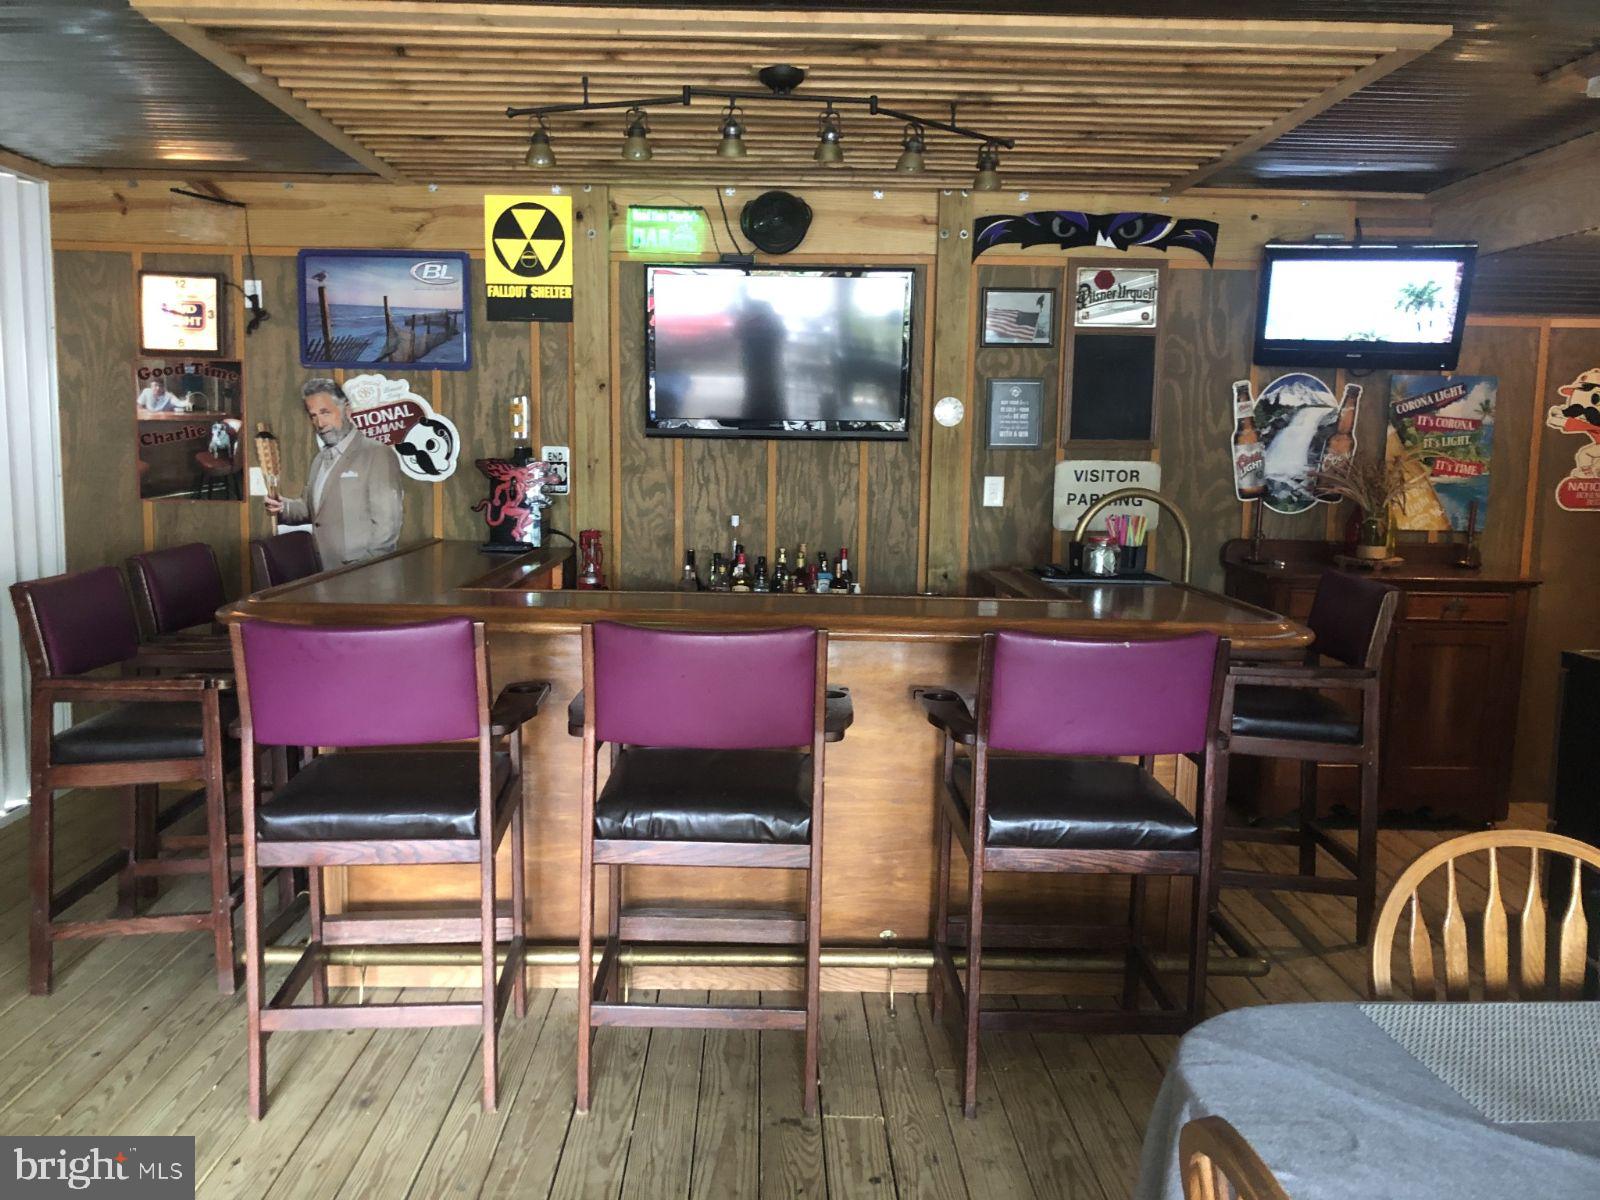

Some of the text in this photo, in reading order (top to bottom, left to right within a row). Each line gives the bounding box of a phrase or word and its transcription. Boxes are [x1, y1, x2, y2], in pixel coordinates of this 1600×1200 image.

[422, 264, 454, 279] BL
[487, 285, 572, 299] FALLOUT SHELTER
[1076, 284, 1117, 310] Pilsner
[137, 362, 240, 381] Good Time
[1396, 395, 1434, 415] CORONA
[354, 404, 414, 428] TIONAL
[141, 425, 206, 446] Charlie
[548, 452, 563, 461] END
[1074, 470, 1140, 482] VISITOR
[1568, 482, 1600, 492] NATIO
